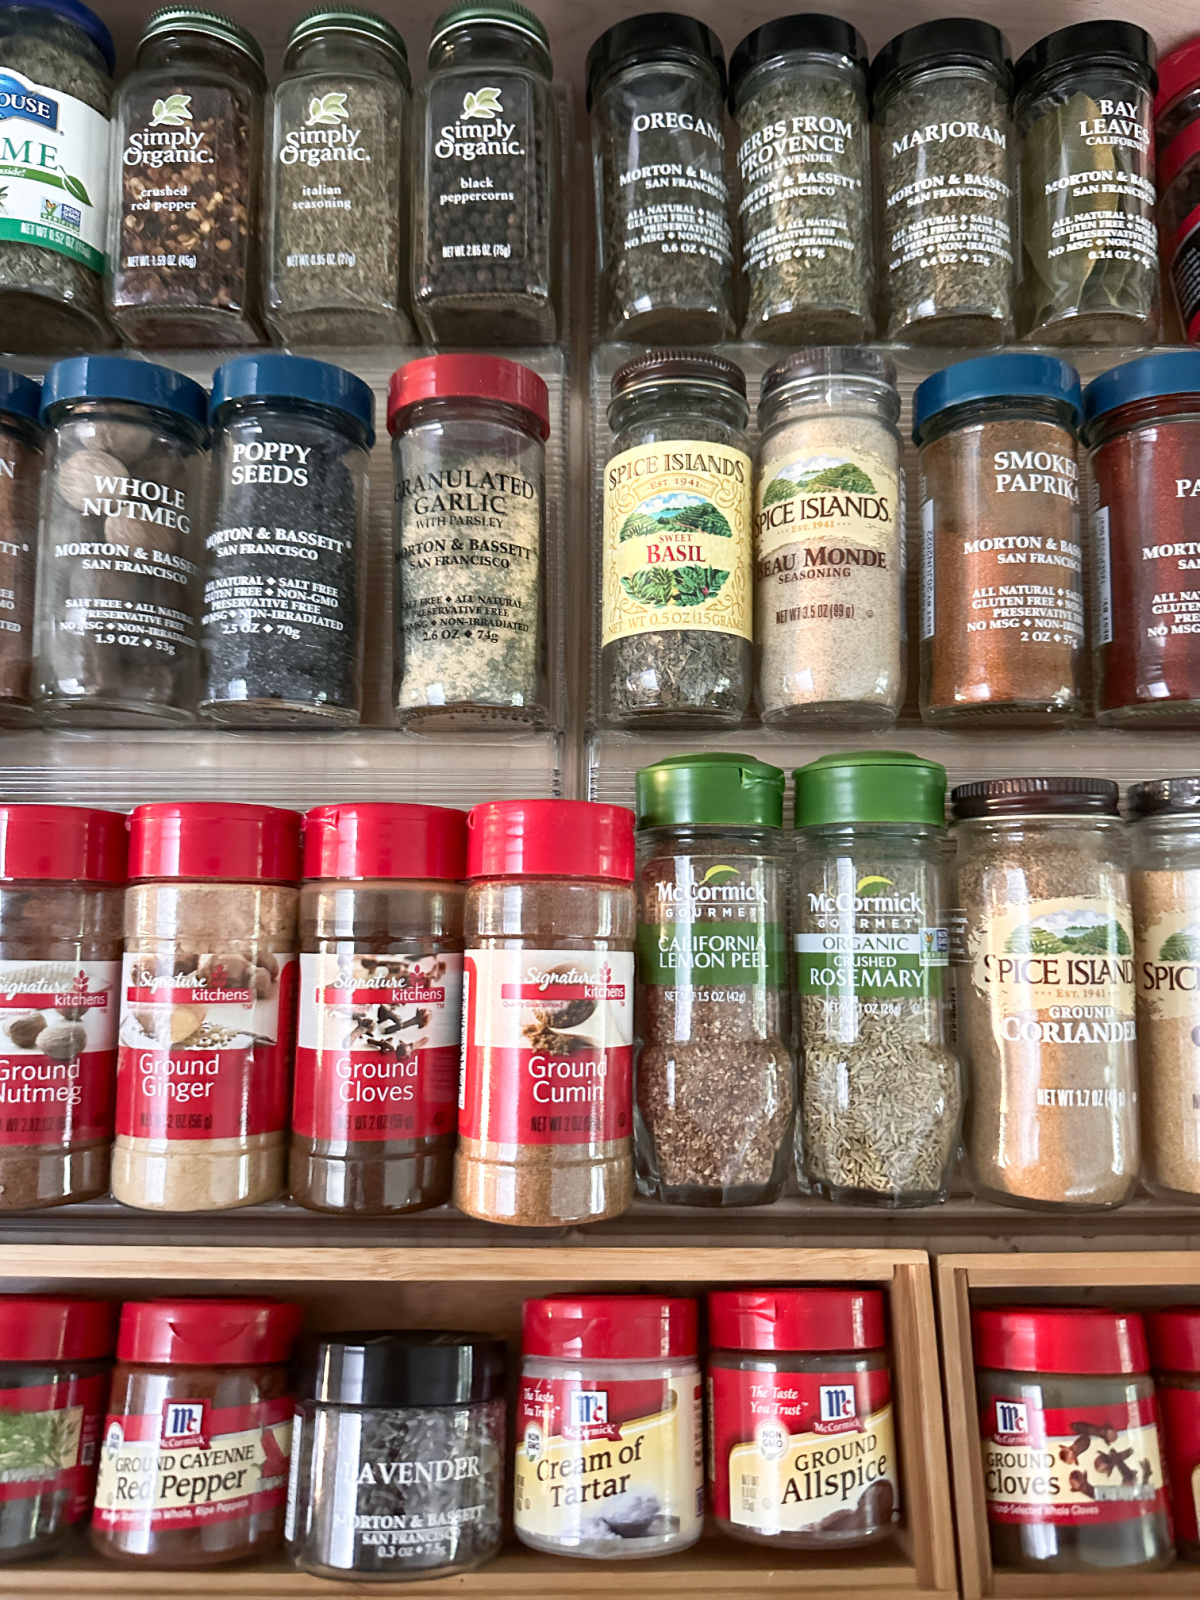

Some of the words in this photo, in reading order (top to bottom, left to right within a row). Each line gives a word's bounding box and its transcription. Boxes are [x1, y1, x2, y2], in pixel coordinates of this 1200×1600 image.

[1099, 99, 1138, 119] BAY
[286, 125, 361, 149] Simply
[441, 119, 516, 145] Simply
[792, 115, 853, 139] FROM
[1079, 119, 1151, 145] LEAVES
[129, 127, 205, 150] Simply
[891, 121, 1007, 158] MARJORAM
[741, 135, 845, 178] PROVENCE
[620, 164, 683, 186] MORTON
[686, 166, 697, 177] &
[748, 165, 772, 183] WITH
[773, 153, 834, 171] LAVENDER
[141, 185, 187, 197] crushed
[302, 185, 341, 196] italian
[461, 177, 493, 189] black
[1045, 170, 1113, 195] MORTON
[1116, 171, 1128, 182] &
[1073, 184, 1100, 197] SAN
[131, 199, 150, 211] red
[154, 199, 196, 212] pepper
[292, 198, 351, 210] seasoning
[440, 191, 514, 205] peppercorns
[749, 198, 768, 216] SAN
[770, 185, 835, 205] FRANCISCO
[907, 192, 931, 208] SAN
[933, 187, 998, 200] FRANCISCO
[627, 208, 646, 220] ALL
[647, 204, 696, 214] NATURAL
[627, 214, 668, 230] GLUTEN
[671, 214, 695, 223] FREE
[1052, 217, 1073, 230] ALL
[1074, 211, 1126, 223] NATURAL
[908, 214, 958, 232] NATURAL
[970, 214, 993, 225] SALT
[1052, 221, 1097, 238] GLUTEN
[1099, 220, 1125, 228] FREE
[624, 238, 639, 250] NO
[641, 232, 665, 244] MSG
[1048, 246, 1065, 259] NO
[1066, 240, 1093, 252] MSG
[920, 257, 937, 268] 0.4
[940, 254, 957, 263] OZ
[972, 254, 990, 267] 12g
[233, 442, 312, 465] POPPY
[231, 464, 309, 487] SEEDS
[609, 455, 659, 491] SPICE
[664, 454, 745, 484] ISLANDS
[94, 475, 186, 510] WHOLE
[414, 492, 508, 516] GARLIC
[82, 498, 191, 534] NUTMEG
[416, 517, 449, 529] WITH
[450, 516, 503, 528] PARSLEY
[754, 502, 795, 538] SPICE
[800, 496, 889, 523] ISLANDS
[659, 533, 693, 543] SWEET
[963, 536, 1042, 555] MORTON
[1046, 538, 1057, 550] &
[55, 543, 130, 558] MORTON
[134, 546, 149, 560] &
[217, 544, 239, 557] SAN
[240, 544, 319, 560] FRANCISCO
[646, 544, 707, 564] BASIL
[82, 559, 113, 570] SAN
[115, 561, 188, 585] FRANCISCO
[411, 558, 431, 570] SAN
[435, 555, 510, 568] FRANCISCO
[756, 553, 796, 581] BEAU
[803, 546, 887, 569] MONDE
[778, 567, 852, 585] SEASONING
[216, 576, 264, 587] NATURAL
[279, 577, 309, 590] SALT
[312, 580, 339, 597] FREE
[972, 587, 996, 599] ALL
[999, 585, 1055, 596] NATURAL
[212, 599, 292, 611] PRESERVATIVE
[295, 601, 321, 614] FREE
[234, 586, 262, 597] FREE
[277, 589, 339, 608] NON-GMO
[971, 598, 1024, 609] GLUTEN
[1026, 597, 1055, 607] FREE
[967, 621, 987, 632] NO
[990, 619, 1020, 628] MSG
[95, 633, 115, 644] 1.9
[118, 634, 140, 647] OZ
[155, 640, 176, 655] 53g
[654, 880, 768, 903] McCormick
[807, 892, 925, 914] McCormick
[658, 935, 766, 952] CALIFORNIA
[822, 936, 910, 951] ORGANIC
[659, 952, 725, 968] LEMON
[730, 952, 769, 968] PEEL
[834, 956, 897, 968] CRUSHED
[984, 954, 1060, 984] SPICE
[1067, 959, 1136, 985] ISLAND
[140, 971, 208, 994] Signature
[334, 971, 407, 996] Signature
[525, 967, 597, 991] Signature
[810, 968, 924, 988] ROSEMARY
[54, 992, 106, 1006] kitchens
[191, 988, 249, 1001] kitchens
[392, 984, 443, 1002] kitchens
[584, 983, 624, 999] kitchens
[1049, 1006, 1115, 1019] GROUND
[1000, 1018, 1137, 1044] CORIANDER
[0, 1059, 80, 1081] Ground
[140, 1052, 220, 1075] Ground
[336, 1055, 419, 1079] Ground
[528, 1055, 608, 1078] Ground
[142, 1075, 214, 1101] Ginger
[339, 1080, 414, 1103] Cloves
[532, 1080, 604, 1104] Cumin
[524, 1387, 534, 1400] The
[535, 1389, 555, 1403] Taste
[751, 1385, 769, 1398] The
[771, 1387, 798, 1399] Taste
[751, 1401, 769, 1415] You
[762, 1430, 782, 1438] NON
[814, 1419, 861, 1433] McCormick
[762, 1439, 783, 1447] GMO
[795, 1434, 877, 1472] GROUND
[116, 1456, 176, 1472] GROUND
[180, 1444, 255, 1468] CAYENNE
[537, 1451, 612, 1482] Cream
[618, 1435, 645, 1464] of
[986, 1452, 1055, 1468] GROUND
[116, 1477, 153, 1500] Red
[160, 1469, 247, 1503] Pepper
[781, 1454, 887, 1504] Allspice
[985, 1469, 1061, 1495] Cloves
[550, 1474, 631, 1507] Tartar
[362, 1533, 389, 1544] SAN
[390, 1526, 461, 1544] FRANCISCO
[378, 1546, 395, 1558] 0.3
